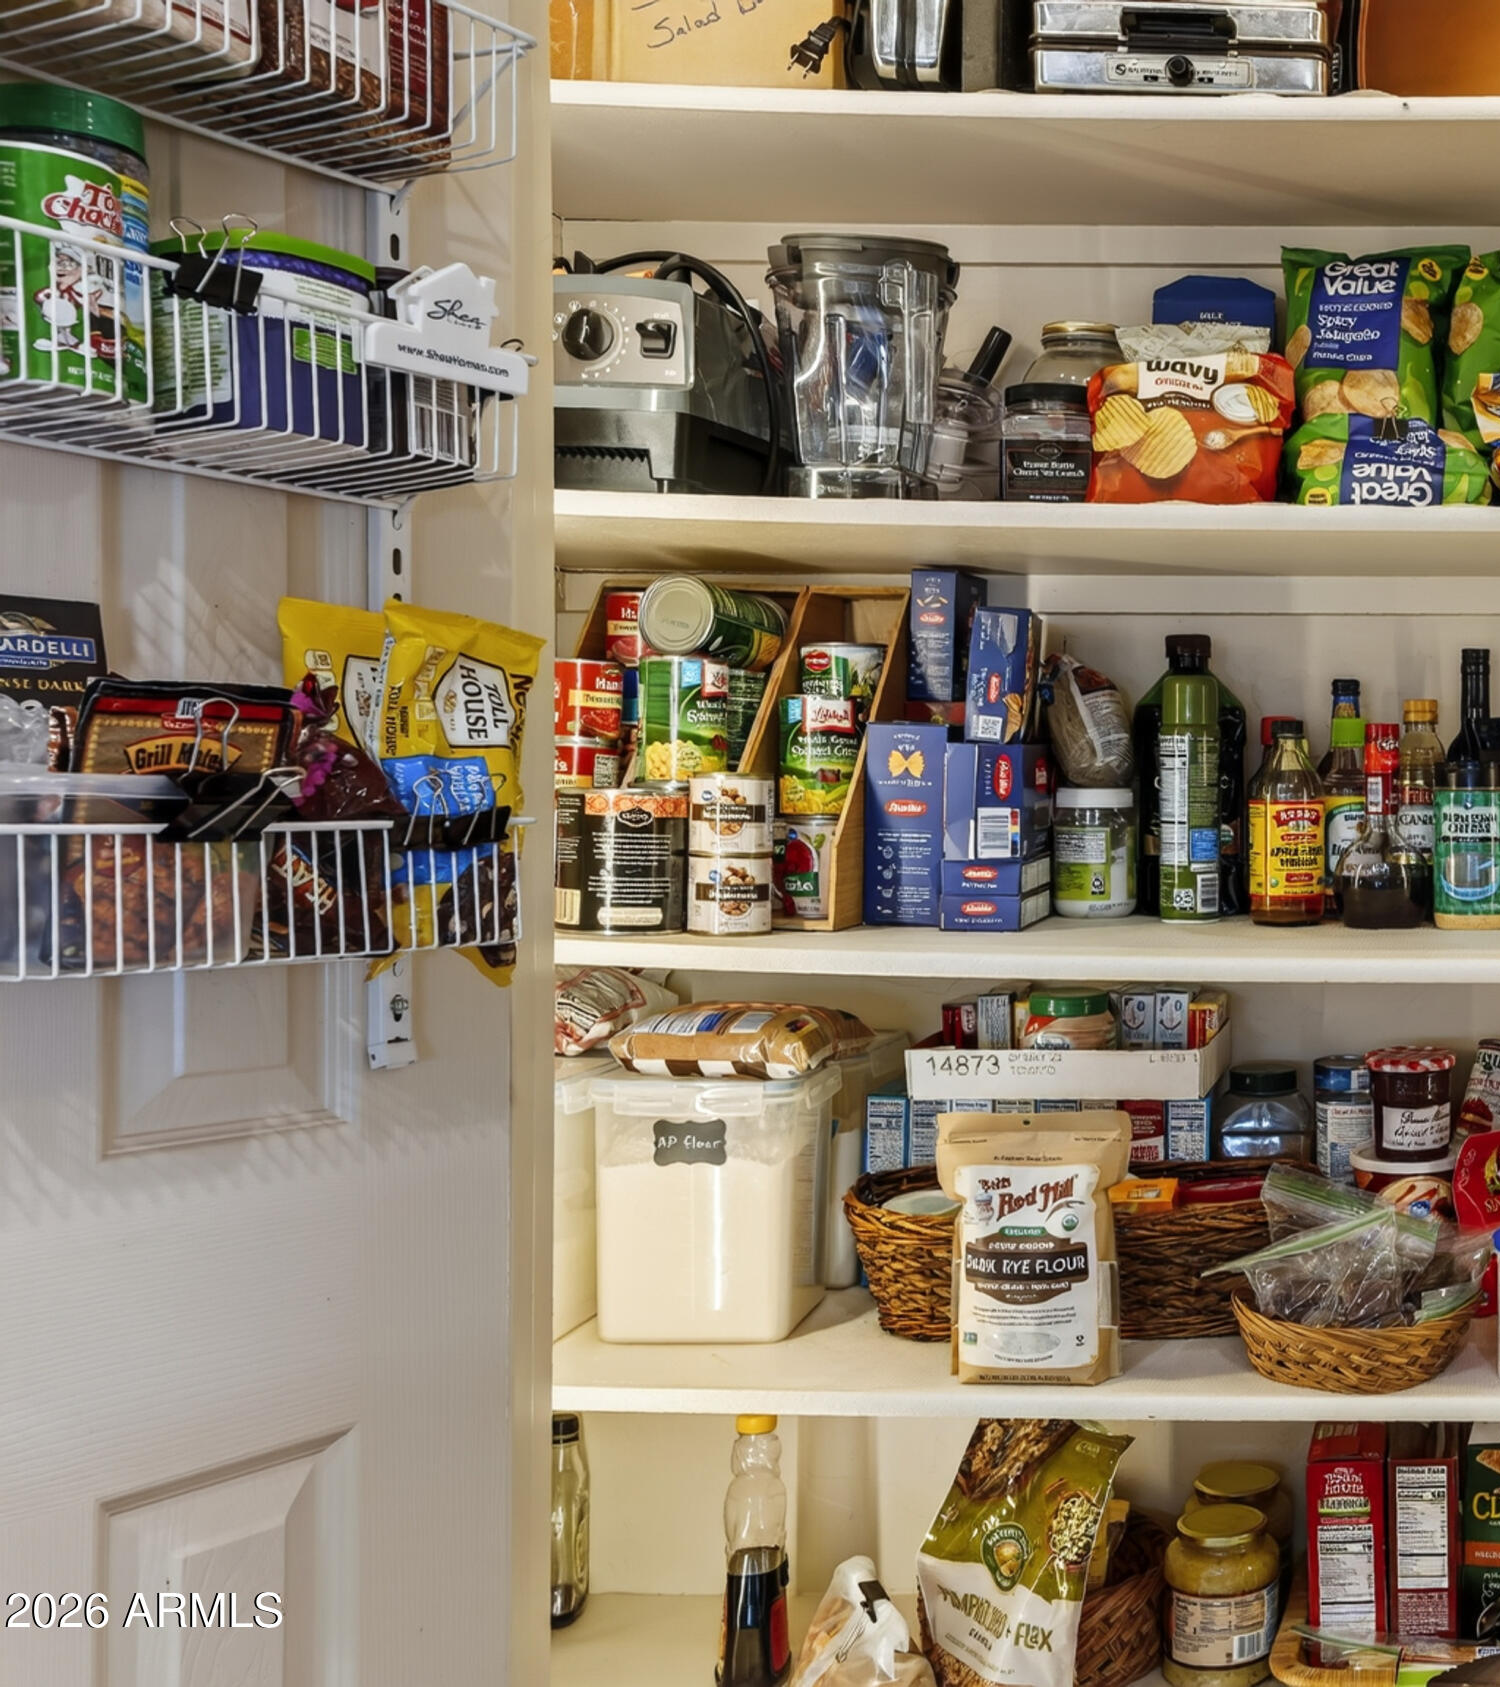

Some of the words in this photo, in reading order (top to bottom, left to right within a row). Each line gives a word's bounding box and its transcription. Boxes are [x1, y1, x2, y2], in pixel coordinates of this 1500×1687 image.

[647, 0, 722, 48] Salad
[1324, 260, 1400, 277] Great
[1323, 277, 1396, 297] Value
[1351, 463, 1432, 482] Value
[1352, 481, 1434, 506] Great
[458, 664, 489, 741] HOUSE
[135, 742, 172, 770] Grill
[926, 1054, 1001, 1077] 14873
[658, 1135, 678, 1149] AP
[996, 1185, 1037, 1223] Red
[1037, 1174, 1079, 1213] Mill
[1001, 1255, 1031, 1275] RYE
[1035, 1254, 1086, 1275] FLOUR
